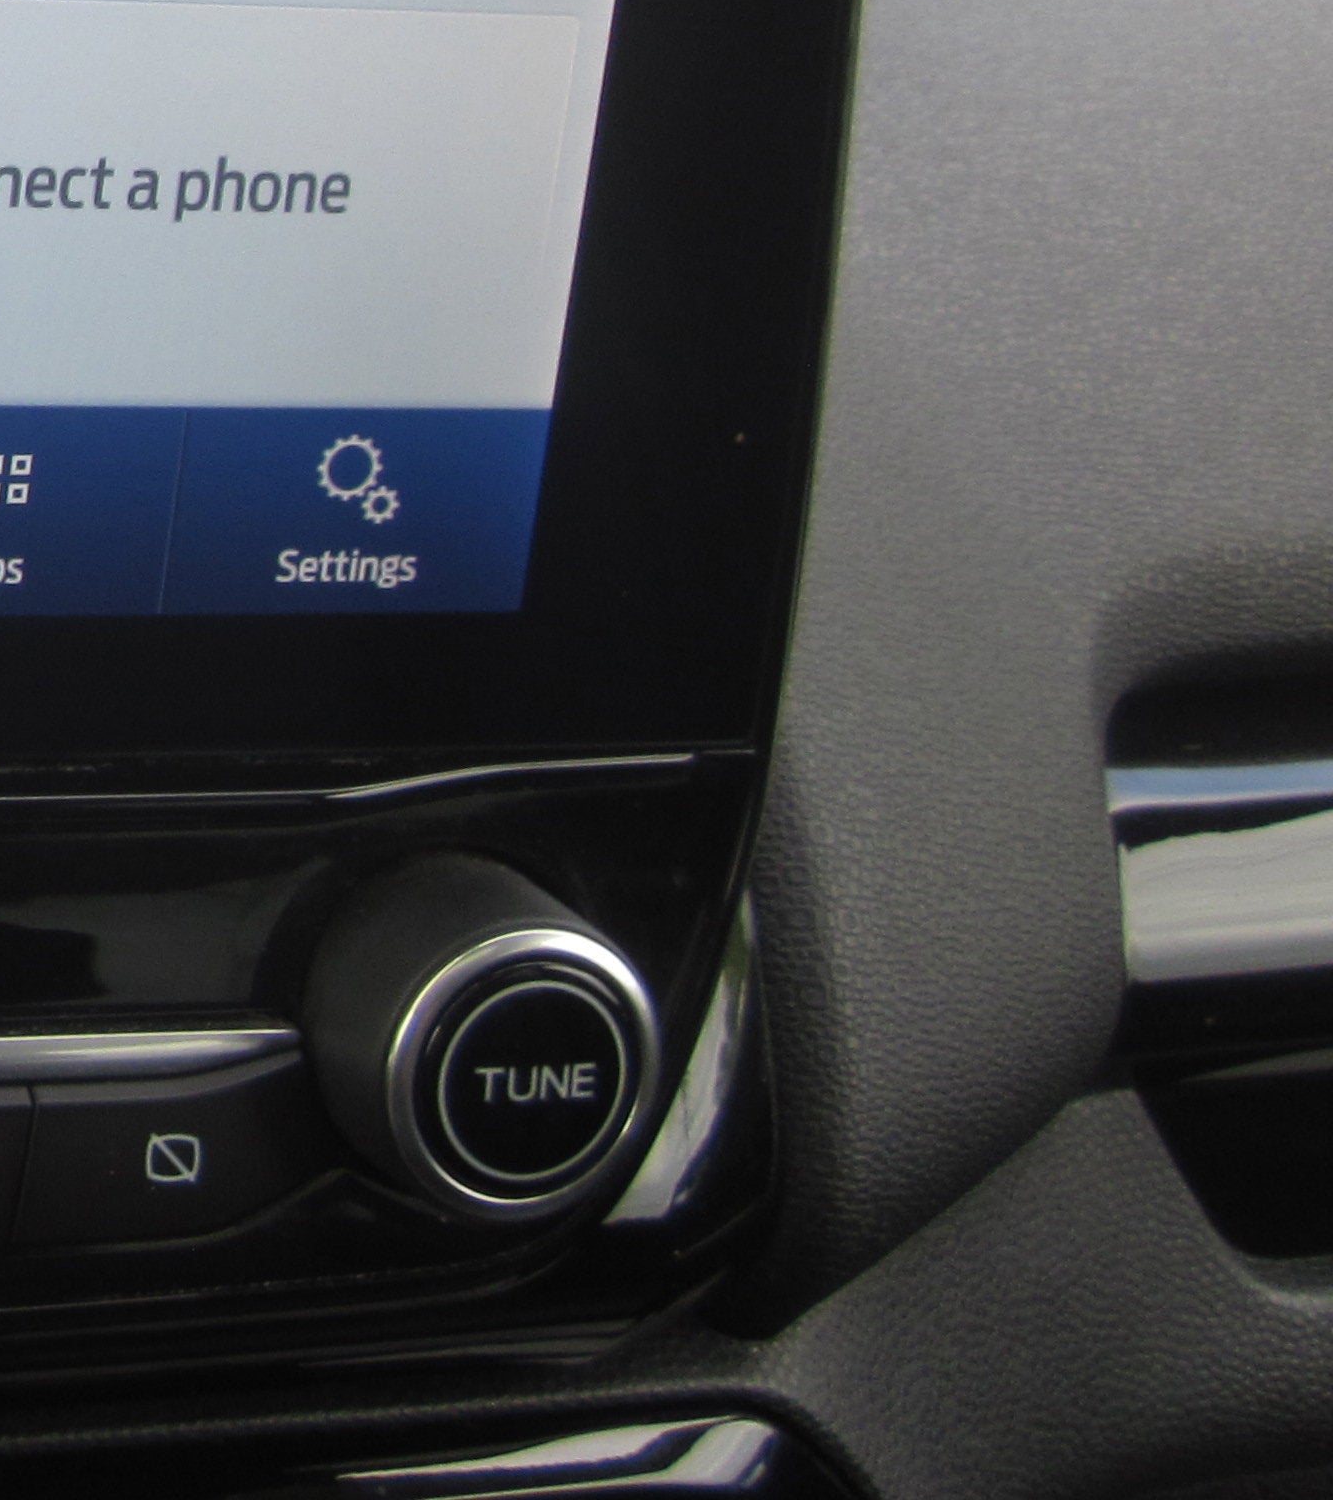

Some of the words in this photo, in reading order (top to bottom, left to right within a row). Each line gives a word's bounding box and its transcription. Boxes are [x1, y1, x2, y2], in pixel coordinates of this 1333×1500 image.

[126, 167, 160, 212] a
[173, 155, 352, 224] phone
[274, 547, 418, 590] Settings
[474, 1061, 597, 1104] TUNE
